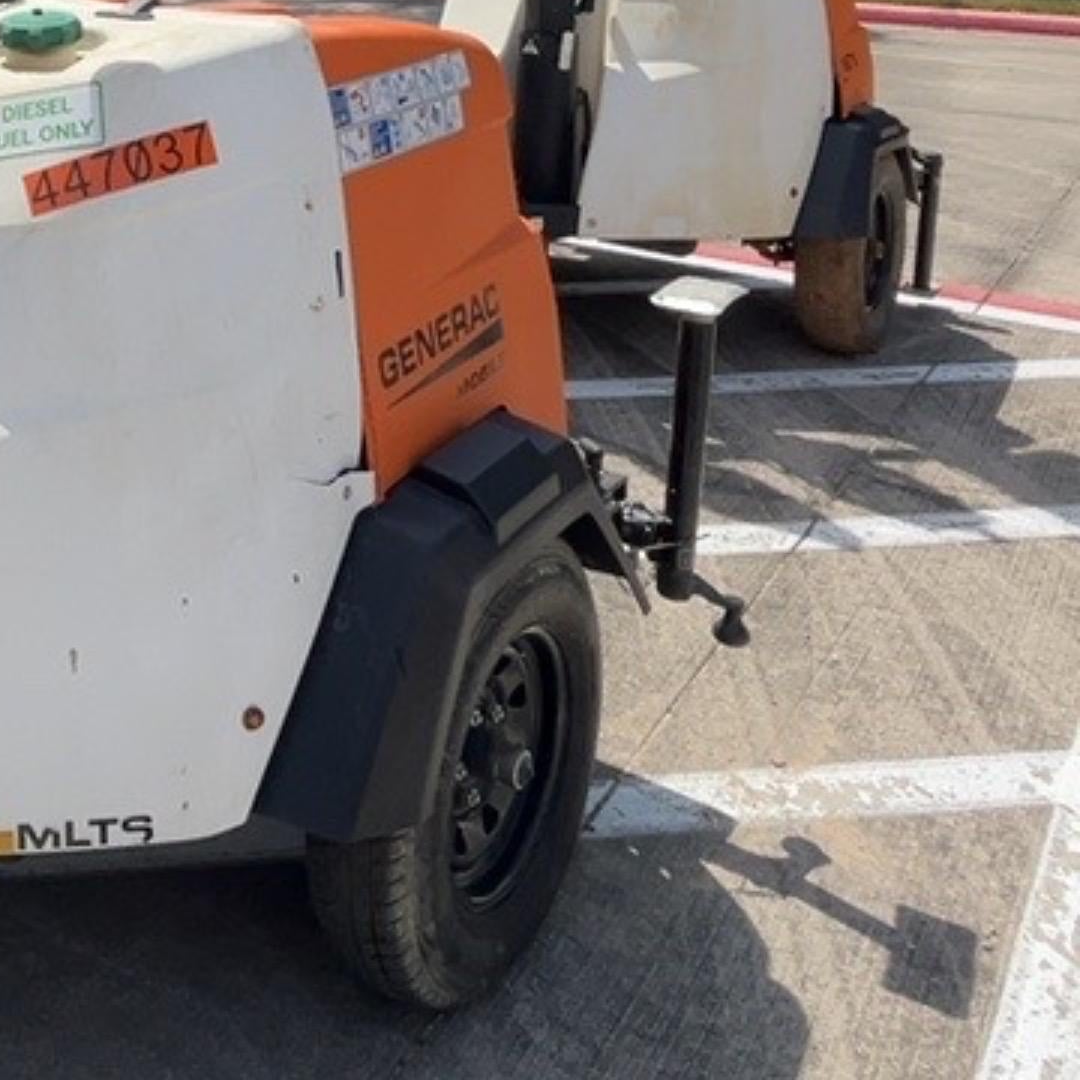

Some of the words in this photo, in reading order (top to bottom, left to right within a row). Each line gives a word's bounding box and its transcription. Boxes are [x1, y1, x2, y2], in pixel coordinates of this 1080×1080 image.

[2, 97, 72, 123] DIESEL
[38, 119, 95, 141] ONLY
[32, 122, 207, 208] 447037
[378, 283, 499, 389] GENERAC
